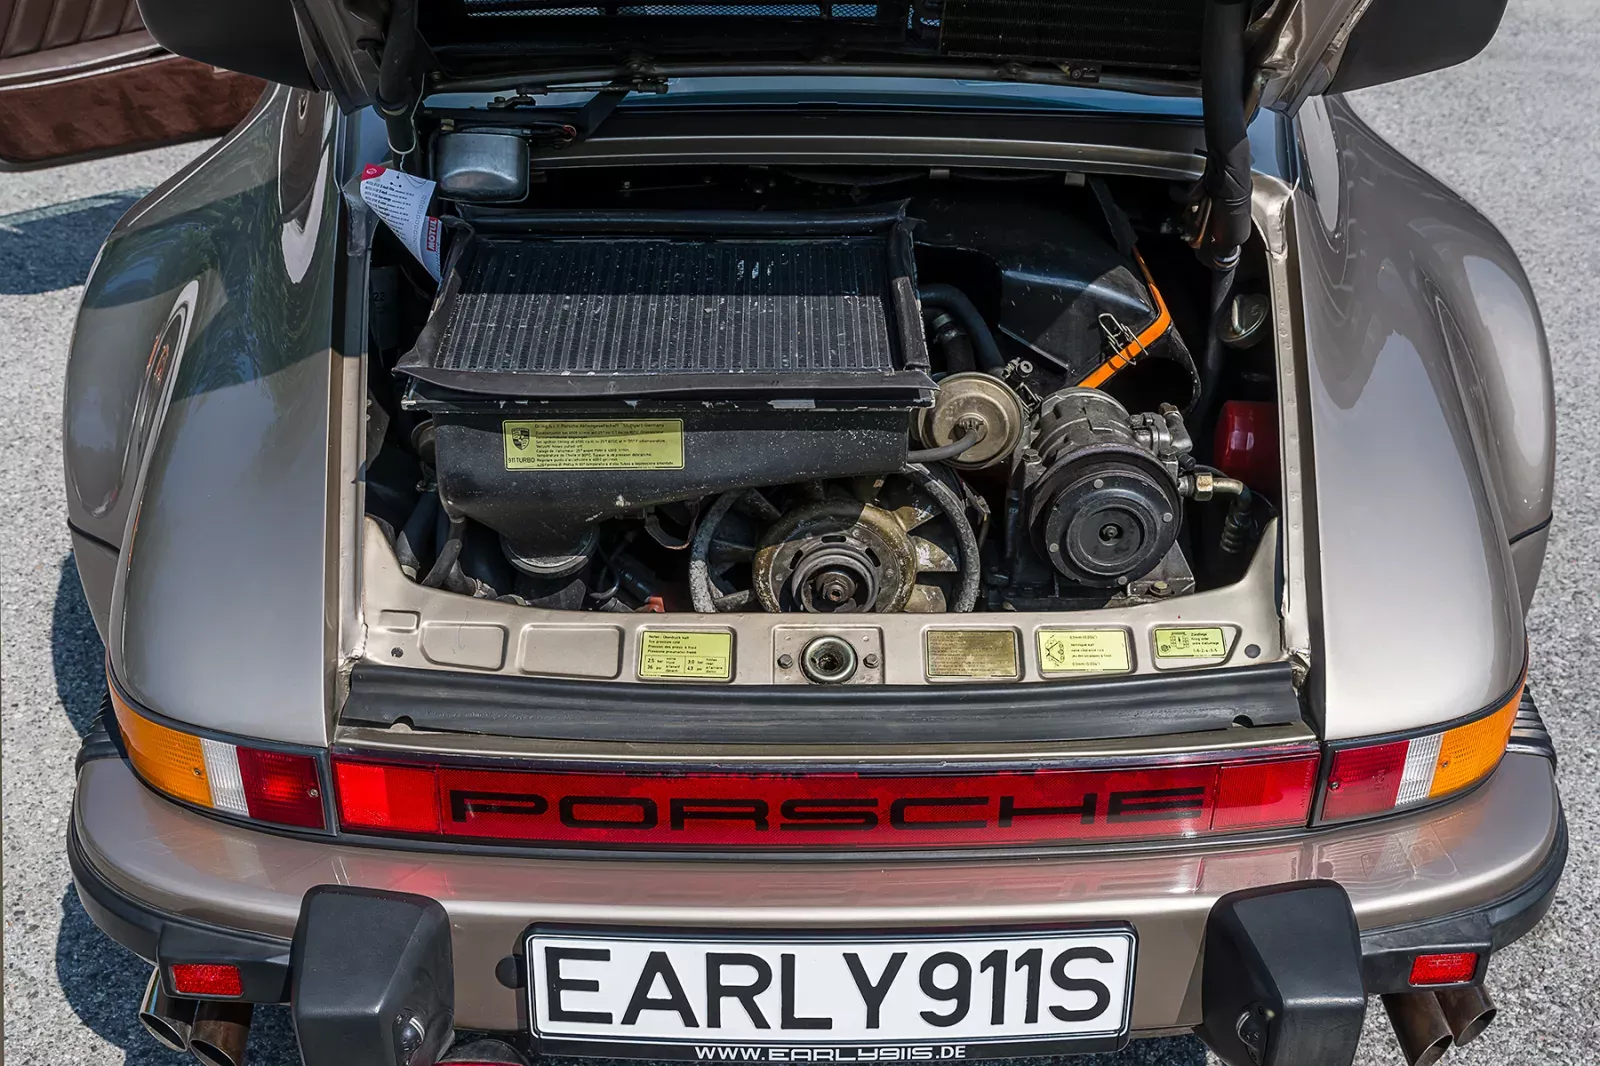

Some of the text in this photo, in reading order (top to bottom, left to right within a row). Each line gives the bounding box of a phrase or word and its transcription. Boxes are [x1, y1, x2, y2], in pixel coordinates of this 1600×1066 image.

[427, 219, 438, 251] MOTUL
[450, 786, 1206, 832] PORSCHE
[695, 1046, 966, 1062] WWW.EARLY911S.DE
